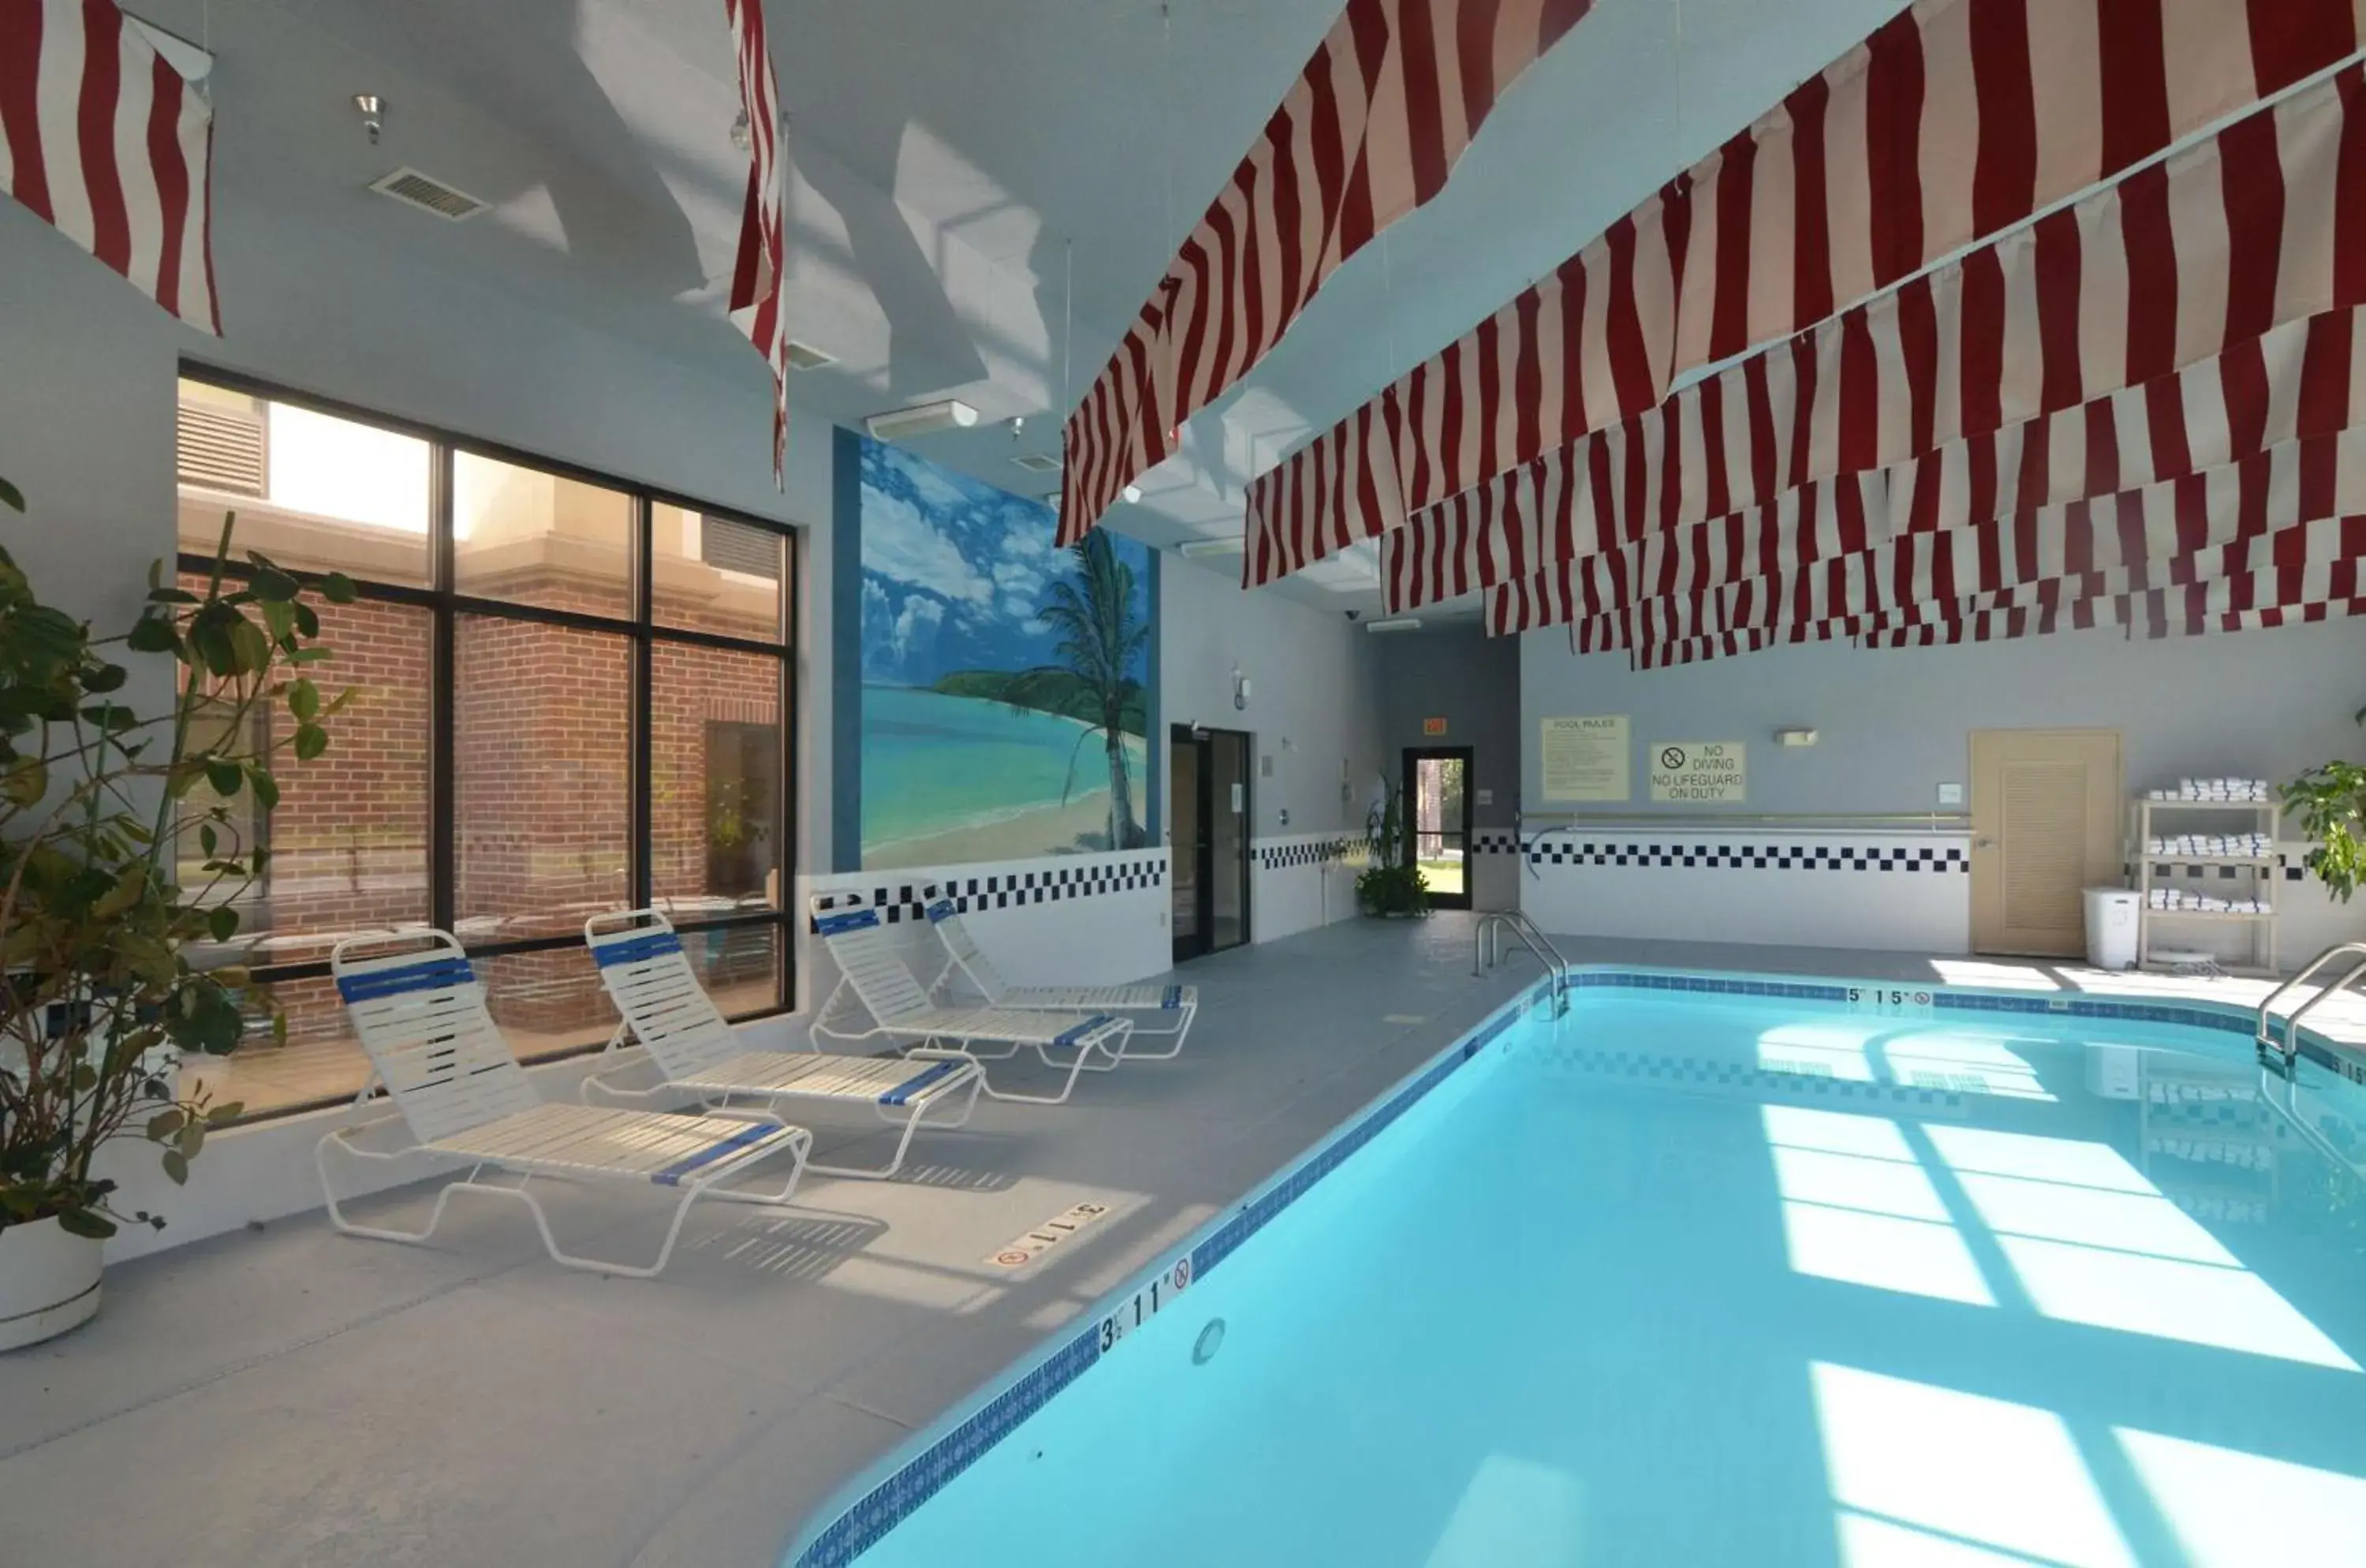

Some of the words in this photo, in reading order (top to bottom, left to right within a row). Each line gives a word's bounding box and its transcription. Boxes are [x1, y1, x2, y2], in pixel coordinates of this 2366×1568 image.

[1704, 745, 1723, 756] NO
[1692, 758, 1734, 771] DIVING
[1652, 775, 1670, 786] NO
[1673, 774, 1742, 786] LIFEGUARD
[1669, 787, 1688, 799] ON
[1690, 787, 1725, 799] DUTY
